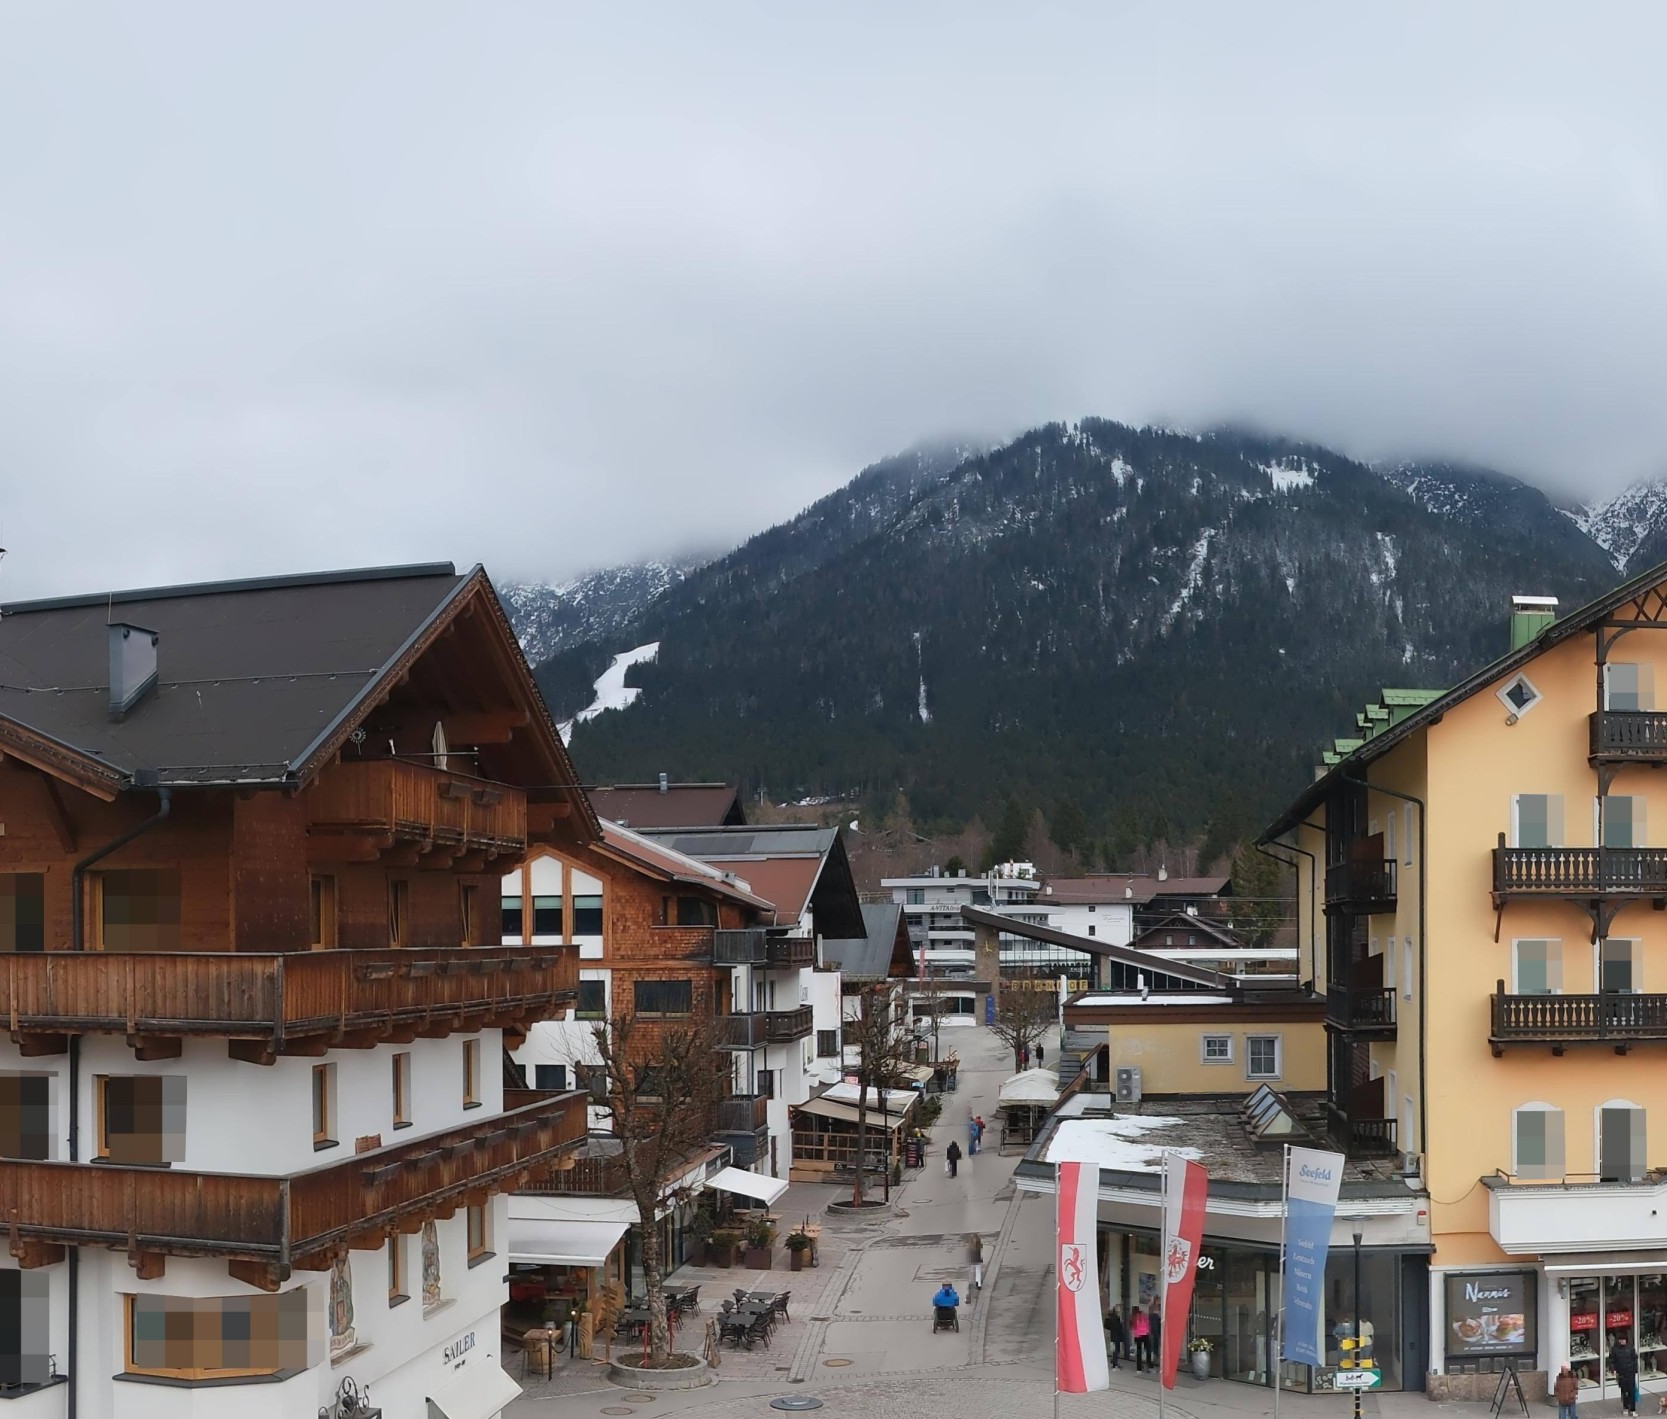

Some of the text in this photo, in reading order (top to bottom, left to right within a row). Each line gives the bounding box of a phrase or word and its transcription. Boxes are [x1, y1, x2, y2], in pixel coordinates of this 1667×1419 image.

[1299, 1164, 1331, 1180] Seefeld
[1609, 1314, 1629, 1323] -20%
[443, 1331, 476, 1366] SAILER
